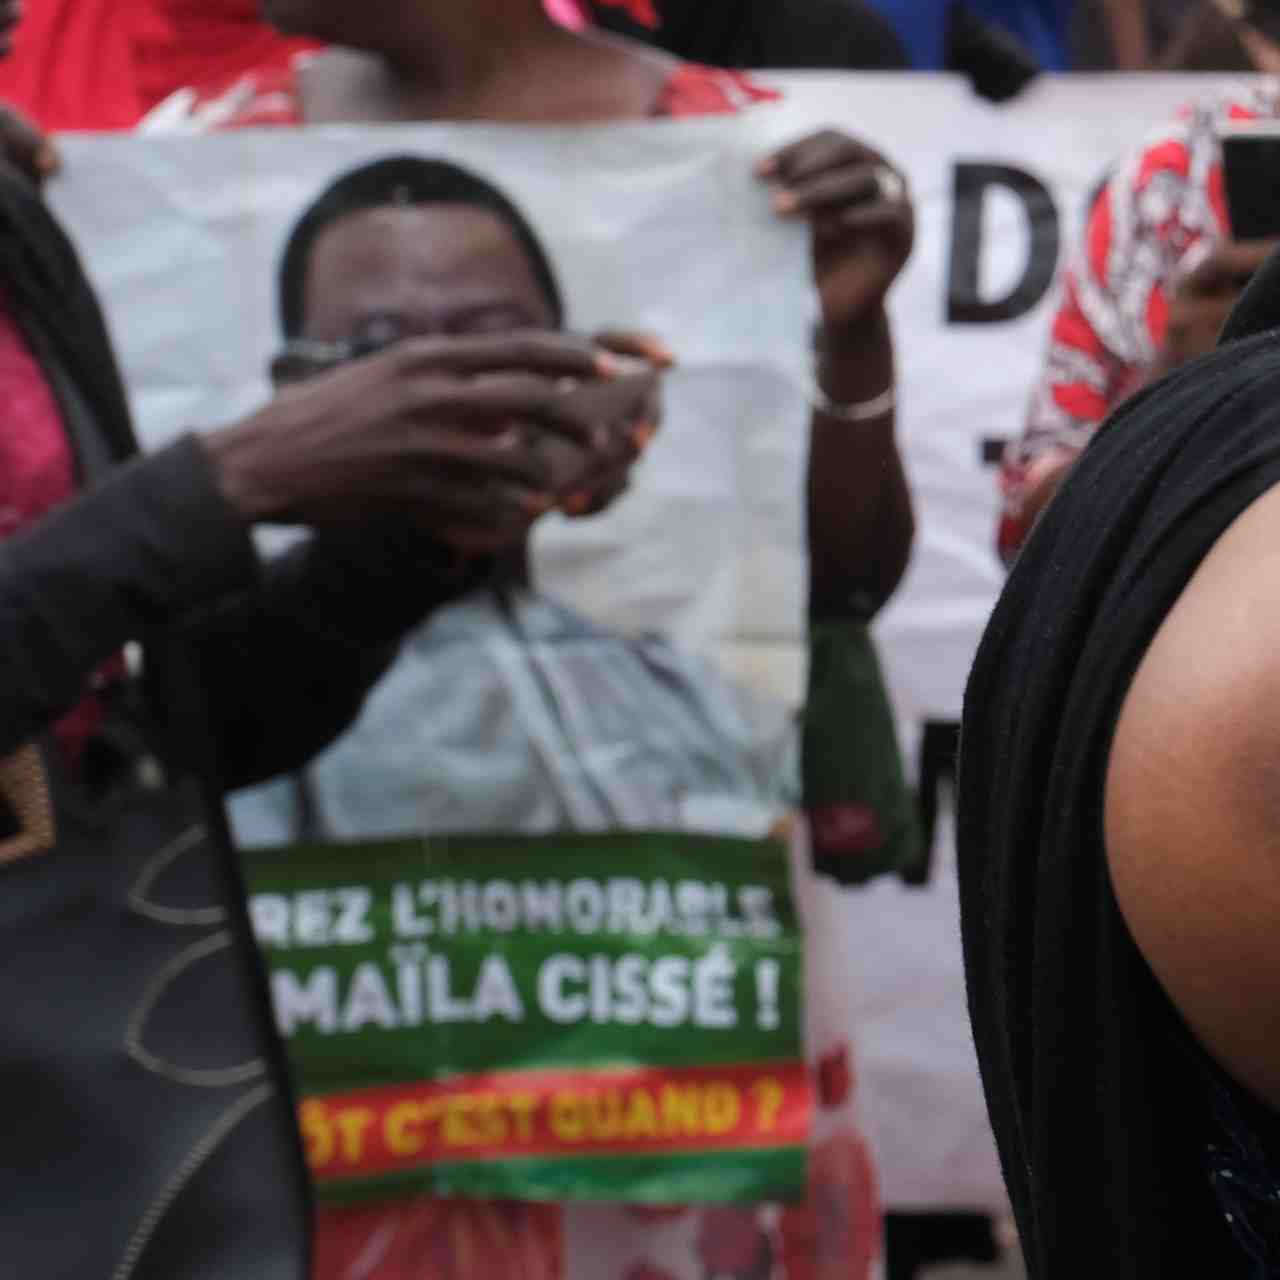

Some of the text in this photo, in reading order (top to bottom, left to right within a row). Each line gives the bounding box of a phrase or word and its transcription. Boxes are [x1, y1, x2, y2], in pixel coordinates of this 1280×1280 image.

[391, 876, 782, 939] L'HONORABLE
[271, 942, 780, 1038] MAÏLA CISSÉ !
[386, 1089, 532, 1154] C'EST
[551, 1081, 740, 1141] QUAND
[754, 1076, 784, 1133] ?
